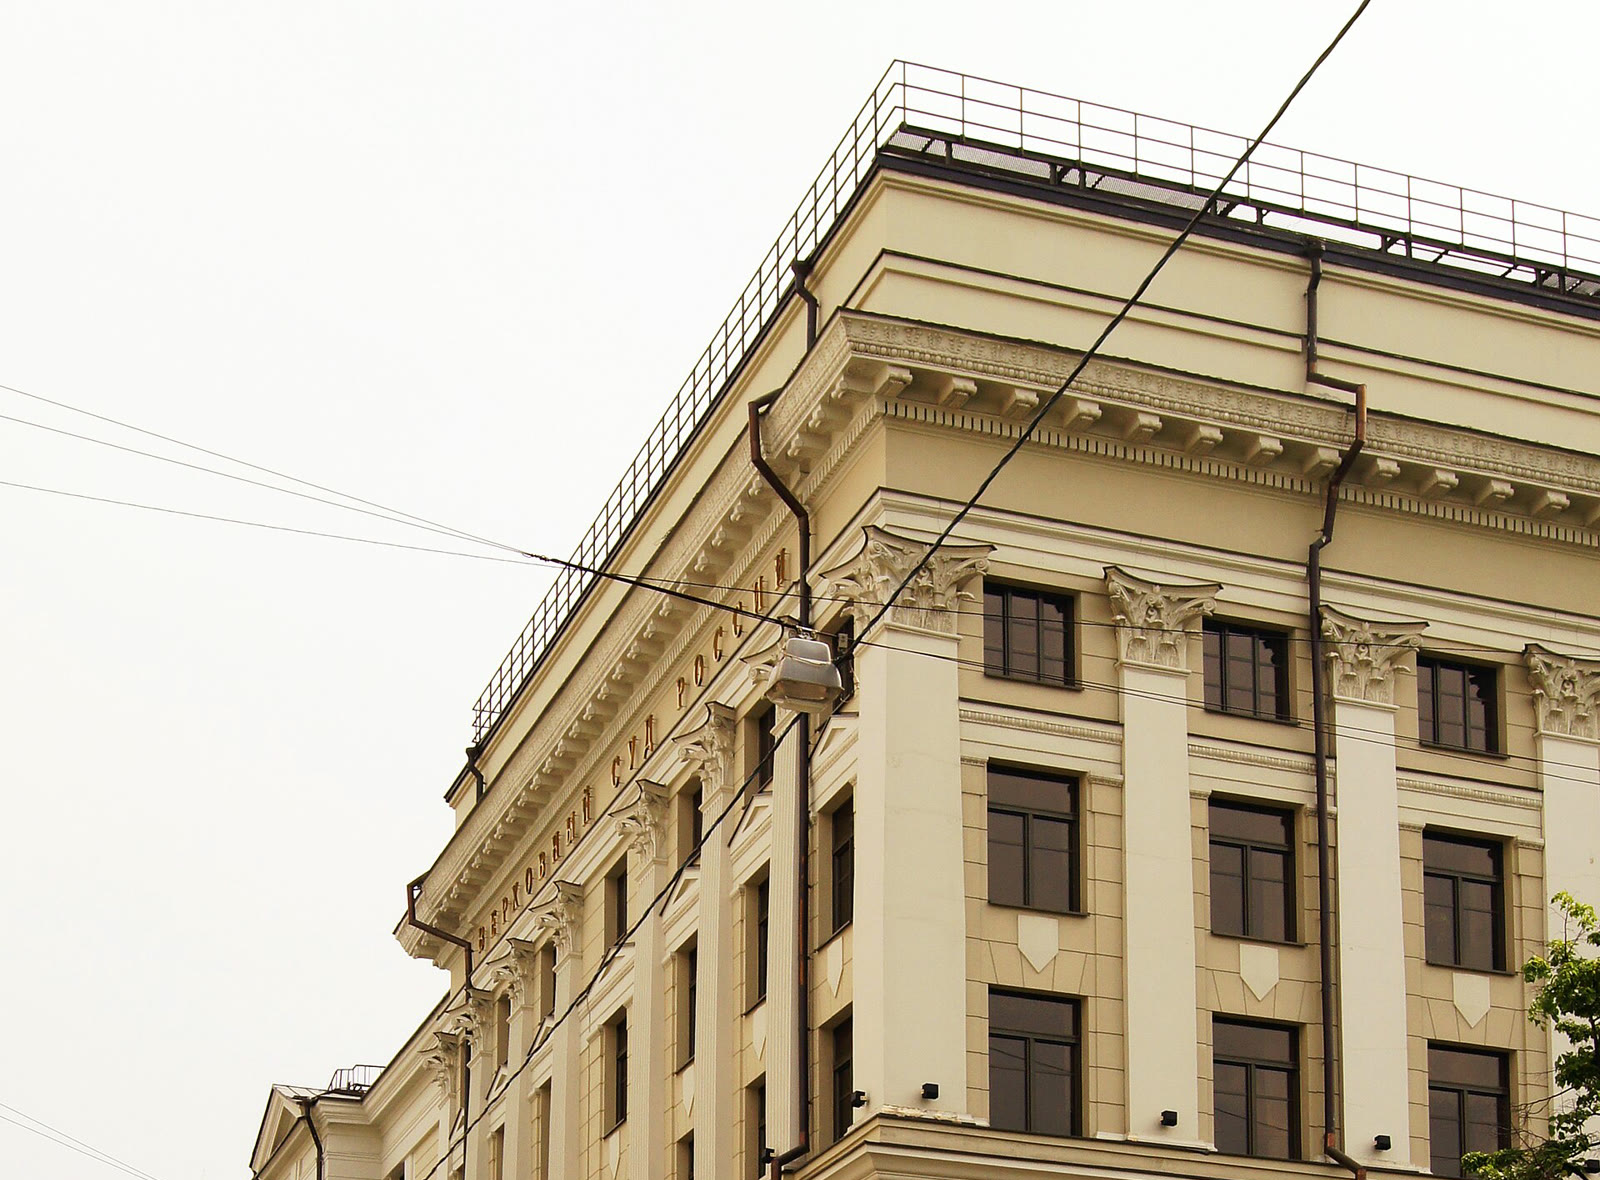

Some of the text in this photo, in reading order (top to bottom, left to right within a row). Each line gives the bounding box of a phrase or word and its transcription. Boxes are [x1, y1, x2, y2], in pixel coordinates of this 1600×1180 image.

[478, 548, 787, 953] ВЕРХОВНЫЙ СУД РОССИИ
